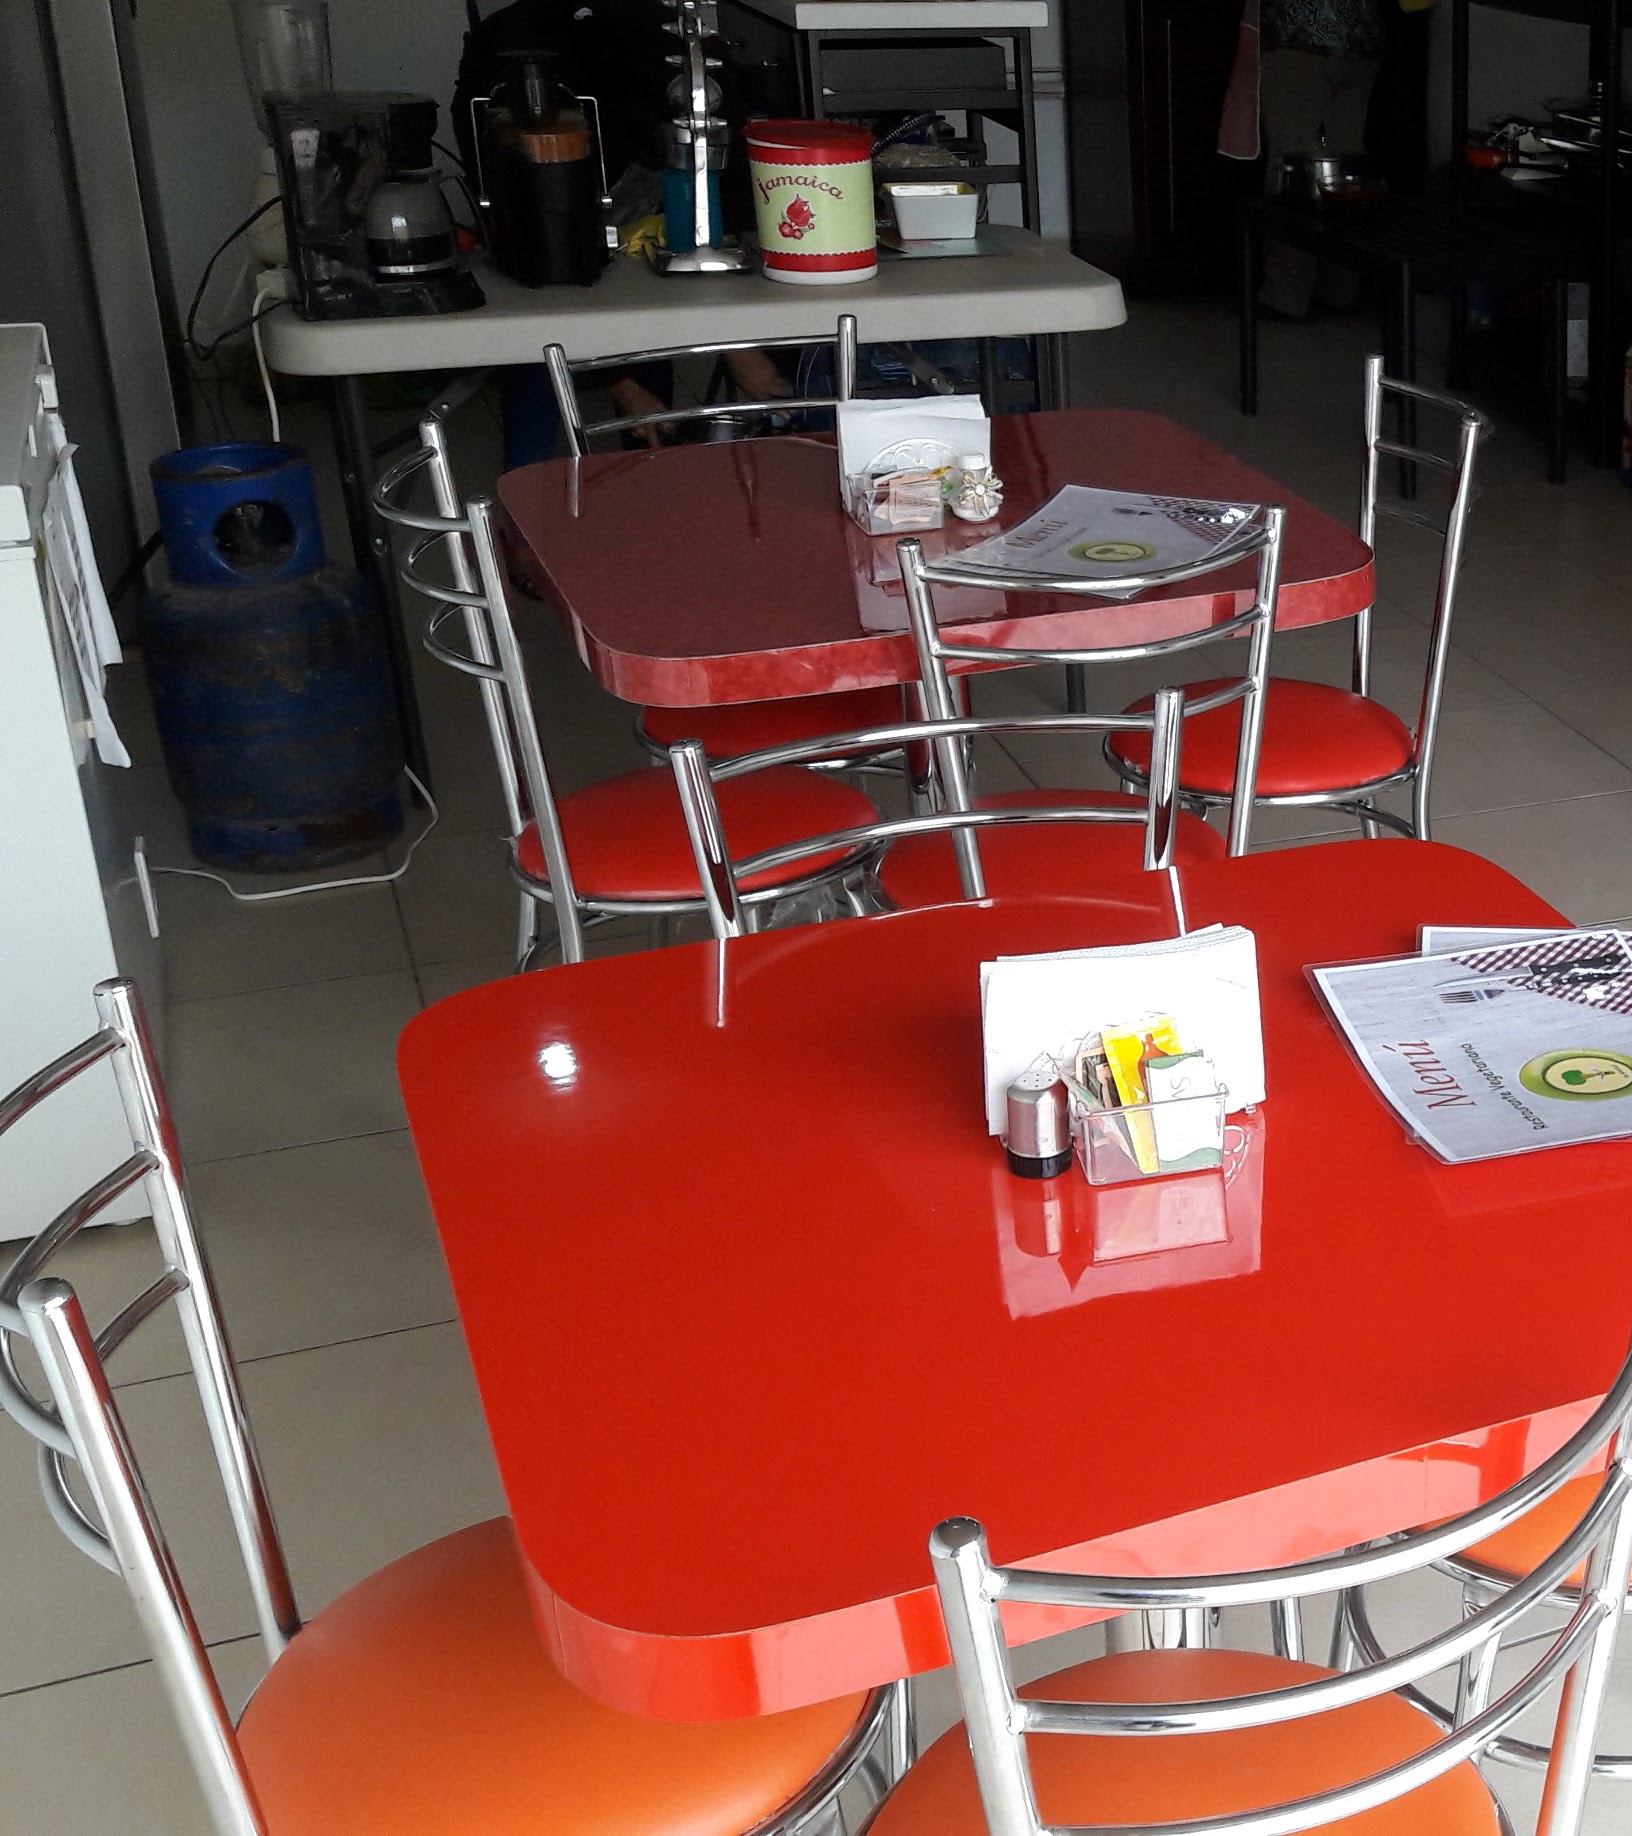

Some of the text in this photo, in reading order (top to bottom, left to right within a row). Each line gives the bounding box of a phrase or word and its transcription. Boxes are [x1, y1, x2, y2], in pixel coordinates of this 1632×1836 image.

[757, 175, 844, 205] jamaica
[1381, 1039, 1478, 1110] Menú
[1460, 1043, 1550, 1131] Restaurante Vegetariano
